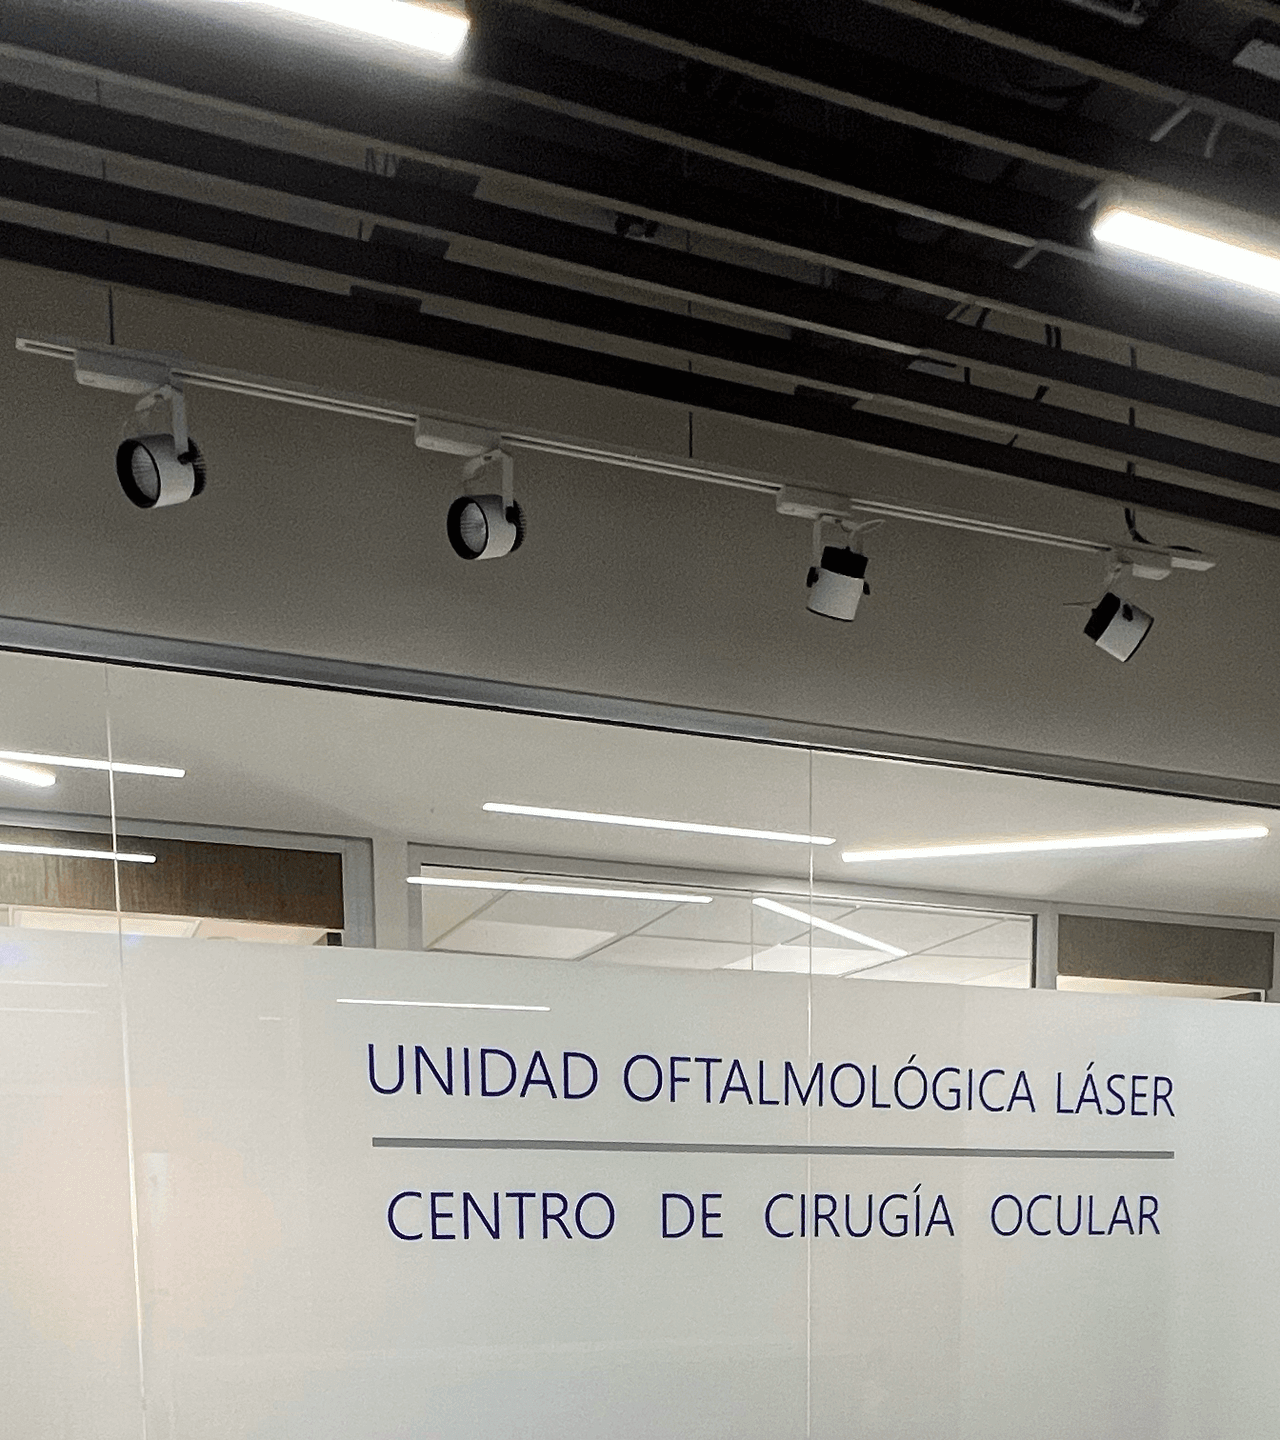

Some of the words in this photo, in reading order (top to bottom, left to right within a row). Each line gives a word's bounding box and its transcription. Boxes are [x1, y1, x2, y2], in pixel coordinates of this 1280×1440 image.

[367, 1043, 599, 1100] UNIDAD
[623, 1053, 1036, 1113] OFTALMOLÓGICA
[1055, 1061, 1176, 1117] LÁSER
[387, 1191, 616, 1241] CENTRO
[661, 1192, 723, 1239] DE
[764, 1183, 956, 1239] CIRUGÍA
[990, 1194, 1161, 1237] OCULAR
